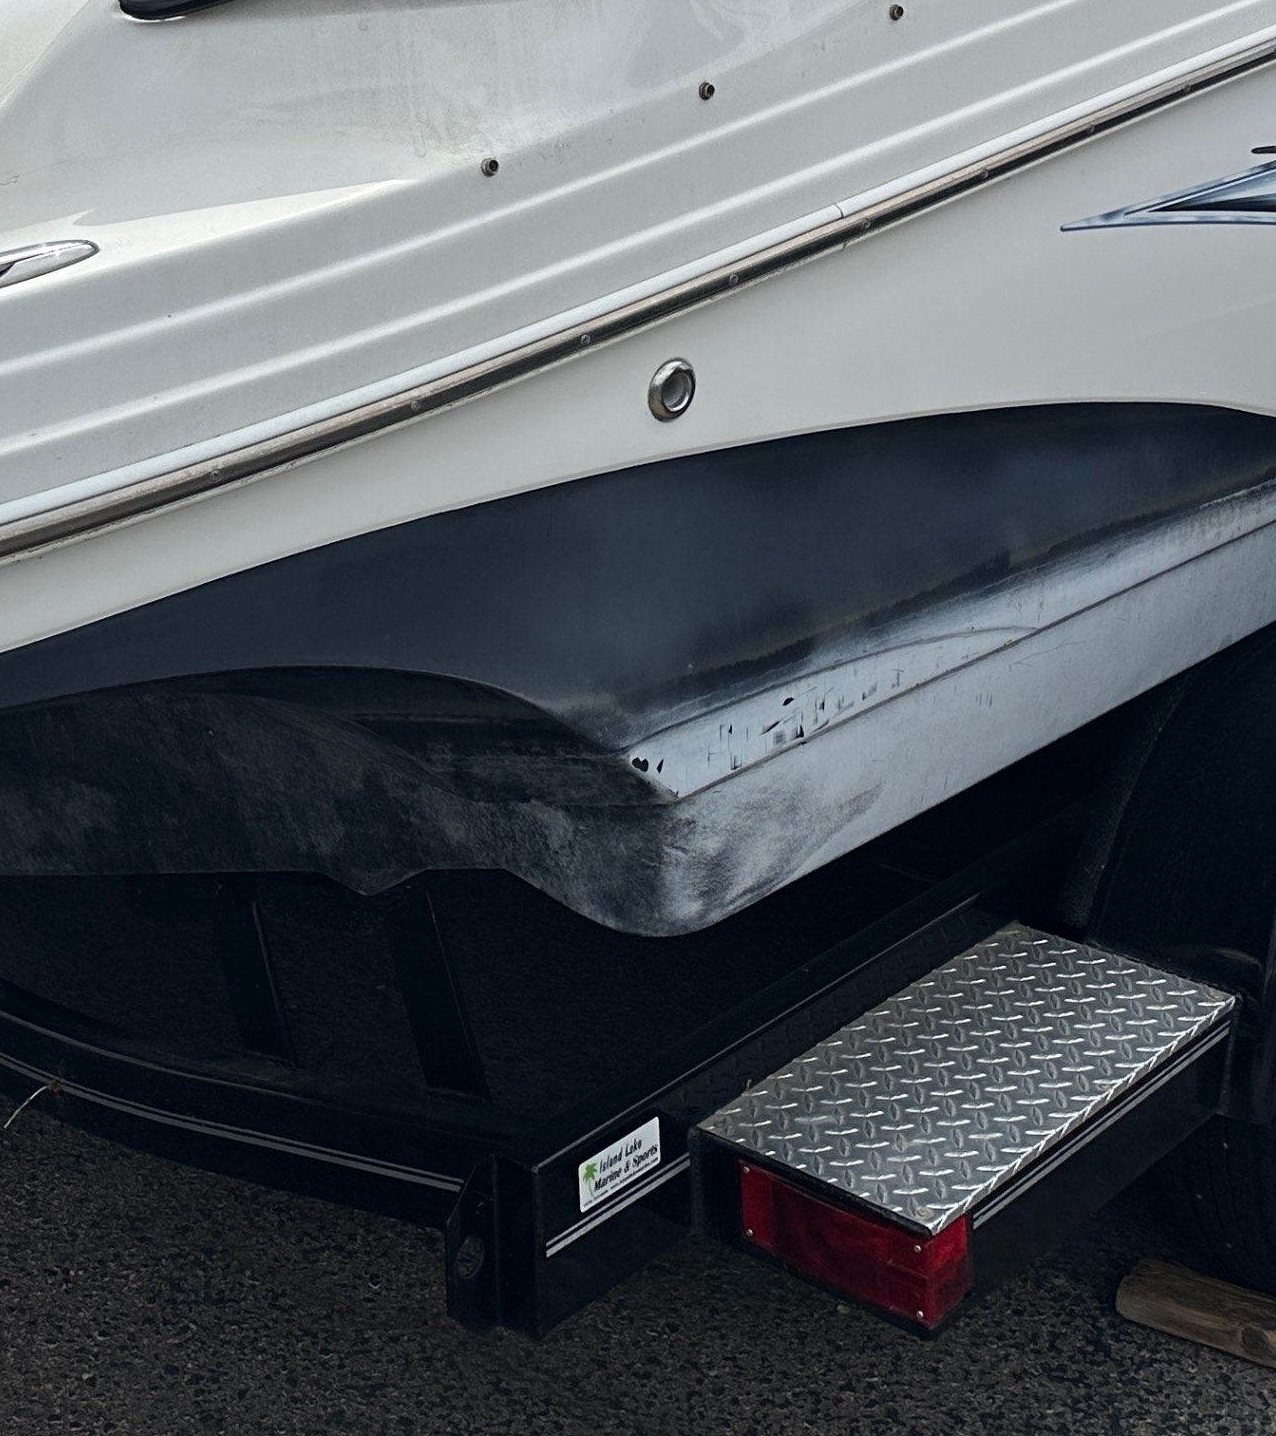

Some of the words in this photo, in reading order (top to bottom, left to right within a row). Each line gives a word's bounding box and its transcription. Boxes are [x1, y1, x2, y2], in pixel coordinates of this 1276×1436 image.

[594, 1167, 623, 1192] Marine
[631, 1144, 658, 1168] Sports
[599, 1146, 623, 1173] Island
[625, 1138, 642, 1158] Lake
